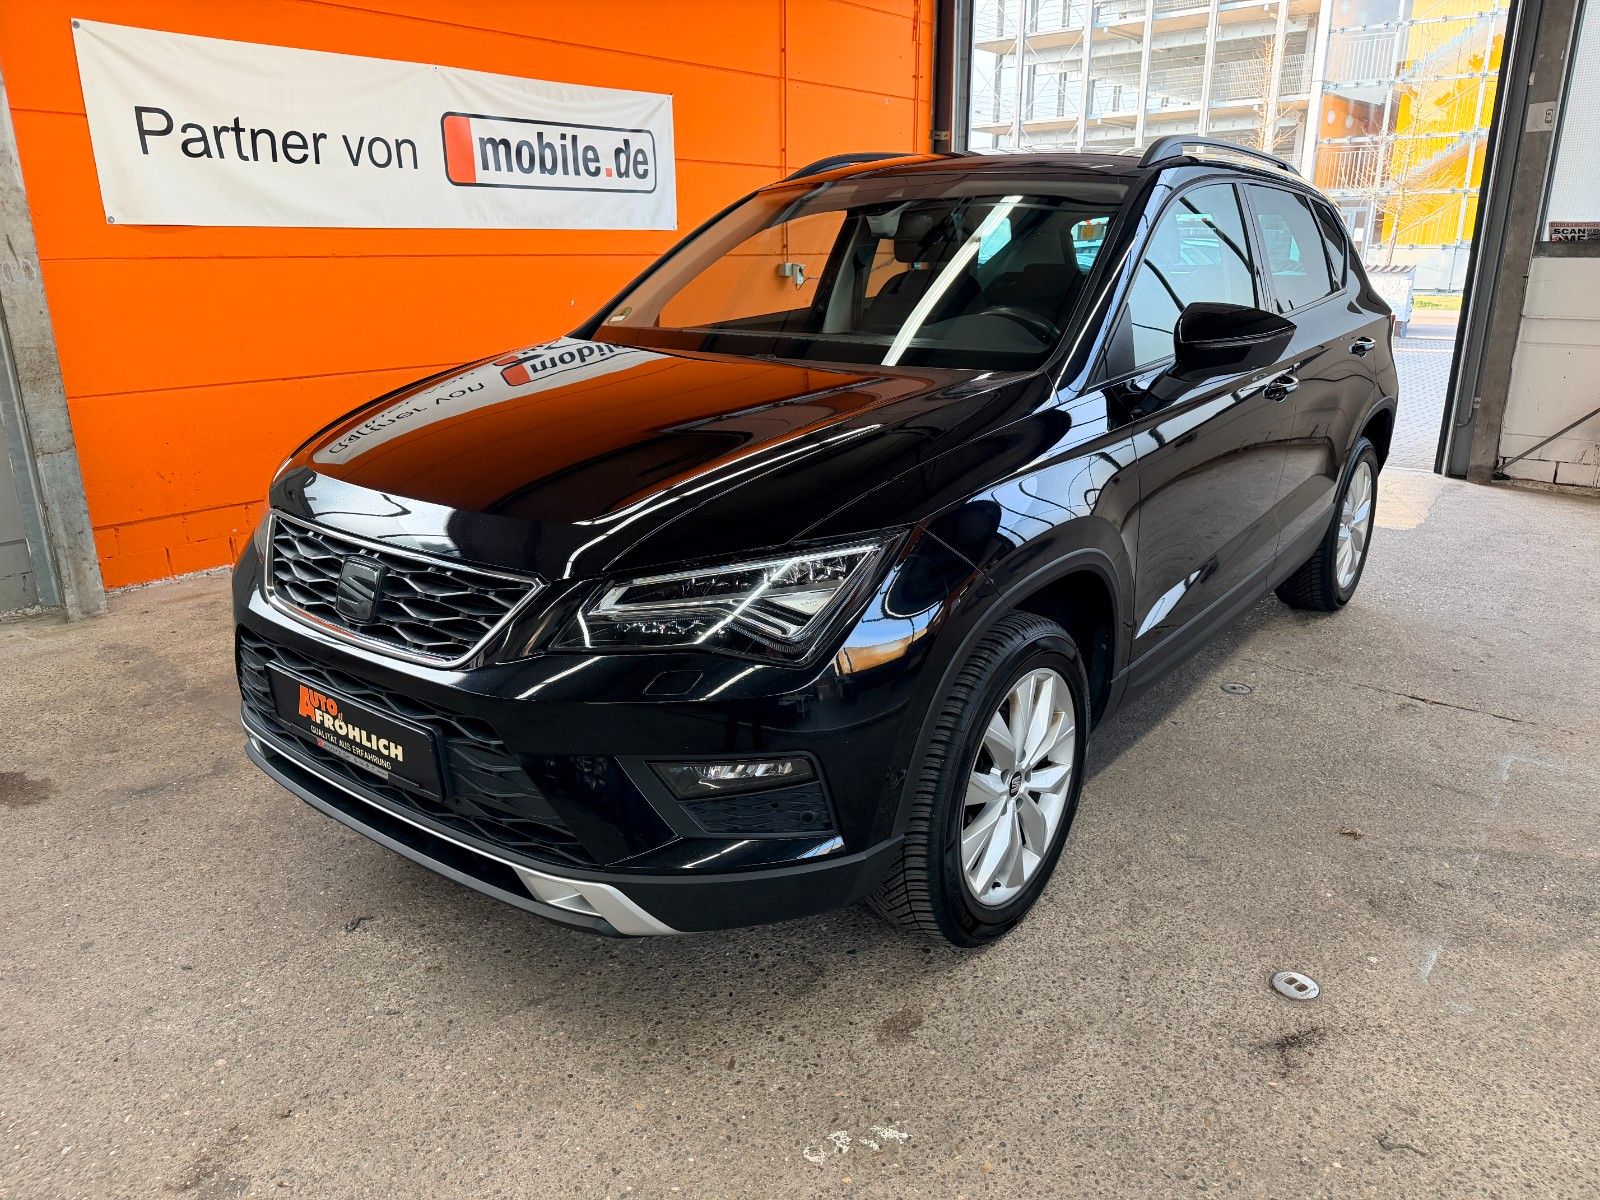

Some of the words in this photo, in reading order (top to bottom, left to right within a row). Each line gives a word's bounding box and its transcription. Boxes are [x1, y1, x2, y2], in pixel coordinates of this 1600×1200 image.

[133, 105, 327, 165] Partner
[343, 133, 418, 170] von
[480, 132, 650, 181] mobile.de
[299, 685, 338, 721] AUTO
[315, 711, 403, 762] FRÖHLICH
[352, 745, 392, 770] ERFAHRUNG
